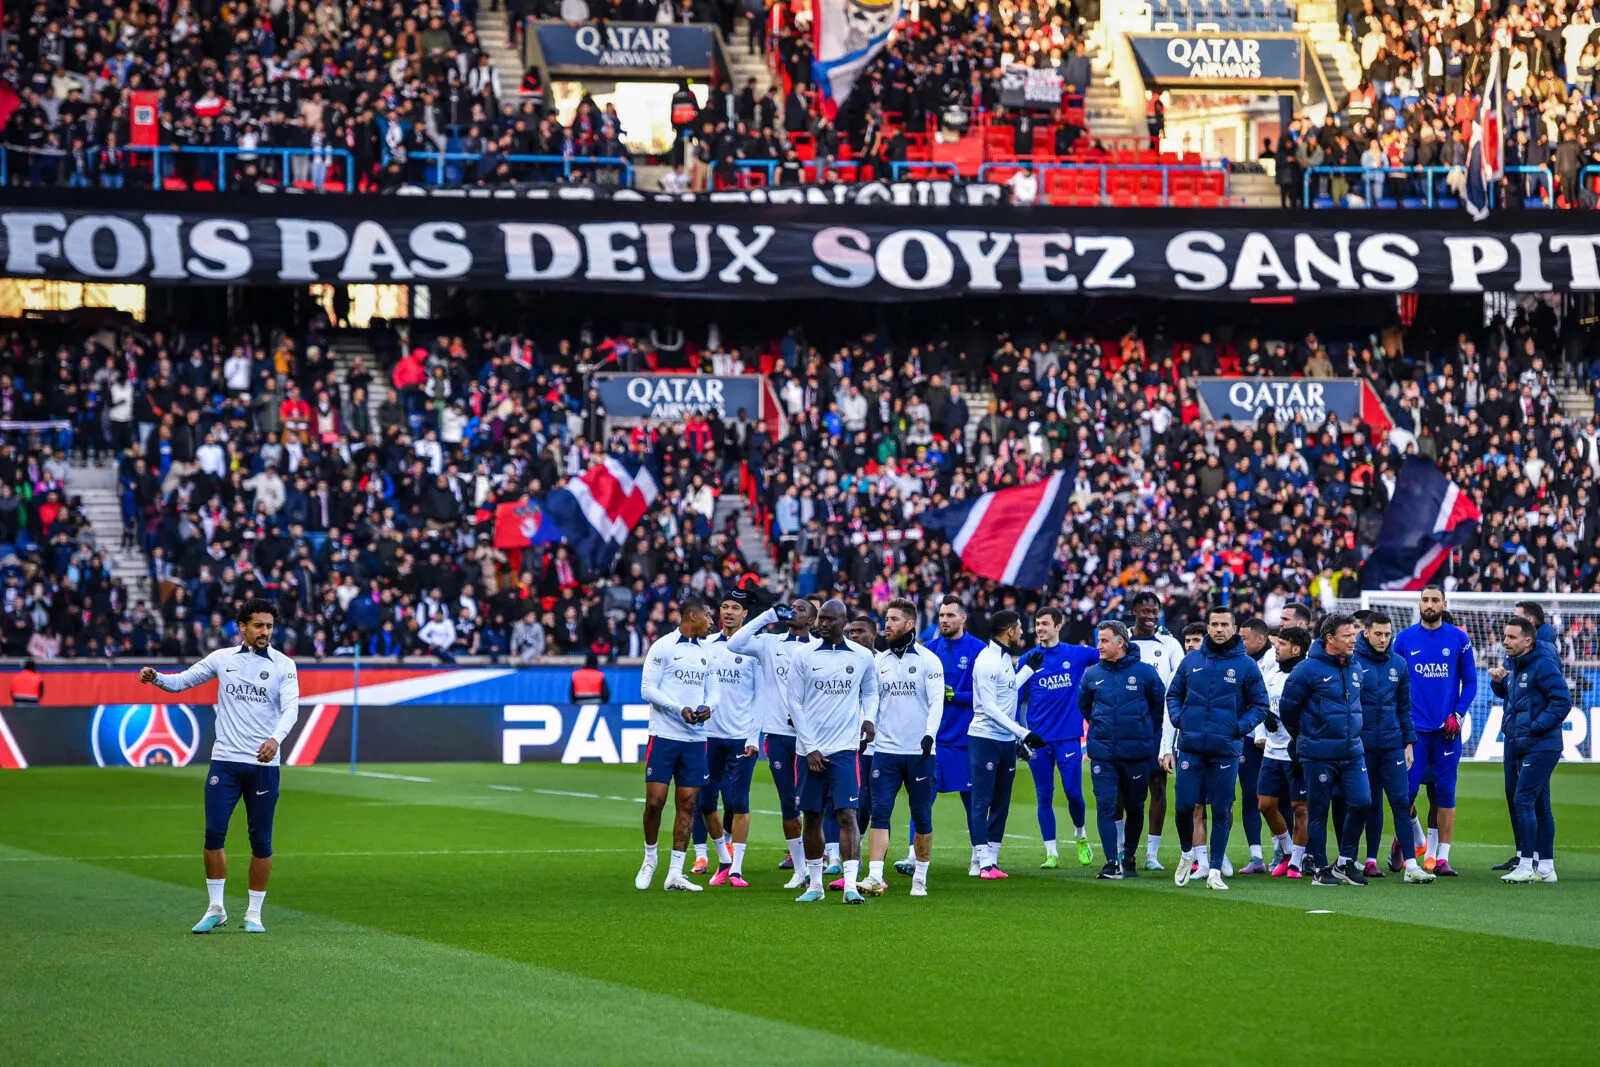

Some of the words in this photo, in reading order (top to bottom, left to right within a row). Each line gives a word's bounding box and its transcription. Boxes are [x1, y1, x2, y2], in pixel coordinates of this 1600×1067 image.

[575, 26, 671, 56] QATAR
[1166, 38, 1261, 68] QATAR
[1189, 62, 1262, 78] AIRWAYS
[3, 212, 253, 279] FOIS
[276, 219, 472, 280] PAS
[501, 222, 778, 284] DEUX
[812, 226, 1136, 290] SOYEZ
[1165, 231, 1420, 291] SANS
[626, 377, 726, 408] QATAR
[1229, 382, 1325, 412] QATAR
[716, 669, 740, 679] ATAR
[1415, 663, 1449, 674] QATAR
[814, 680, 852, 691] QATAR
[882, 681, 916, 692] QATAR
[1038, 673, 1072, 688] QATAR
[1047, 681, 1072, 690] AIRWAYS
[226, 684, 267, 697] QATAR
[235, 694, 267, 703] AIRWAYS
